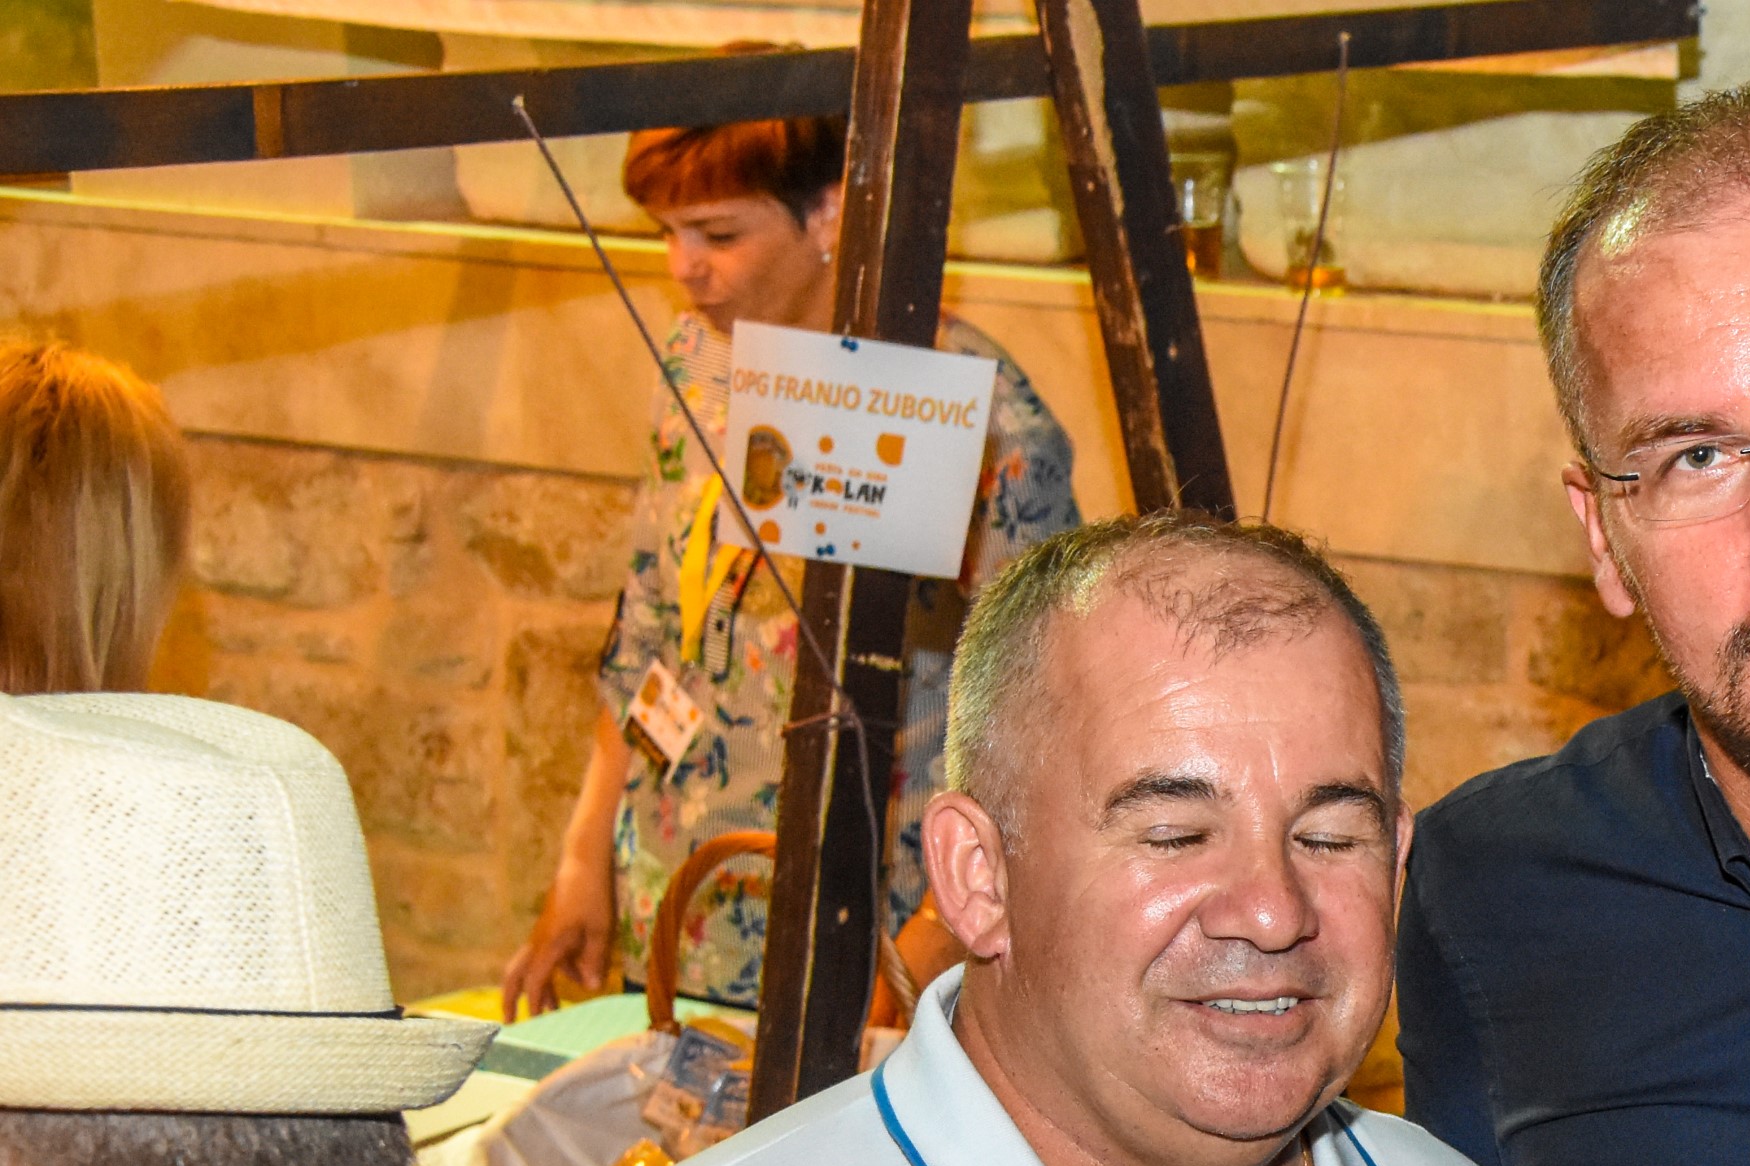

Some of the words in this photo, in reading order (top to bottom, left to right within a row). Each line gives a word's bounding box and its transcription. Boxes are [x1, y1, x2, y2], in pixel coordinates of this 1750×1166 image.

[733, 369, 769, 396] OPG
[774, 375, 861, 410] FRANJO
[867, 388, 978, 428] ZUBOVIĆ
